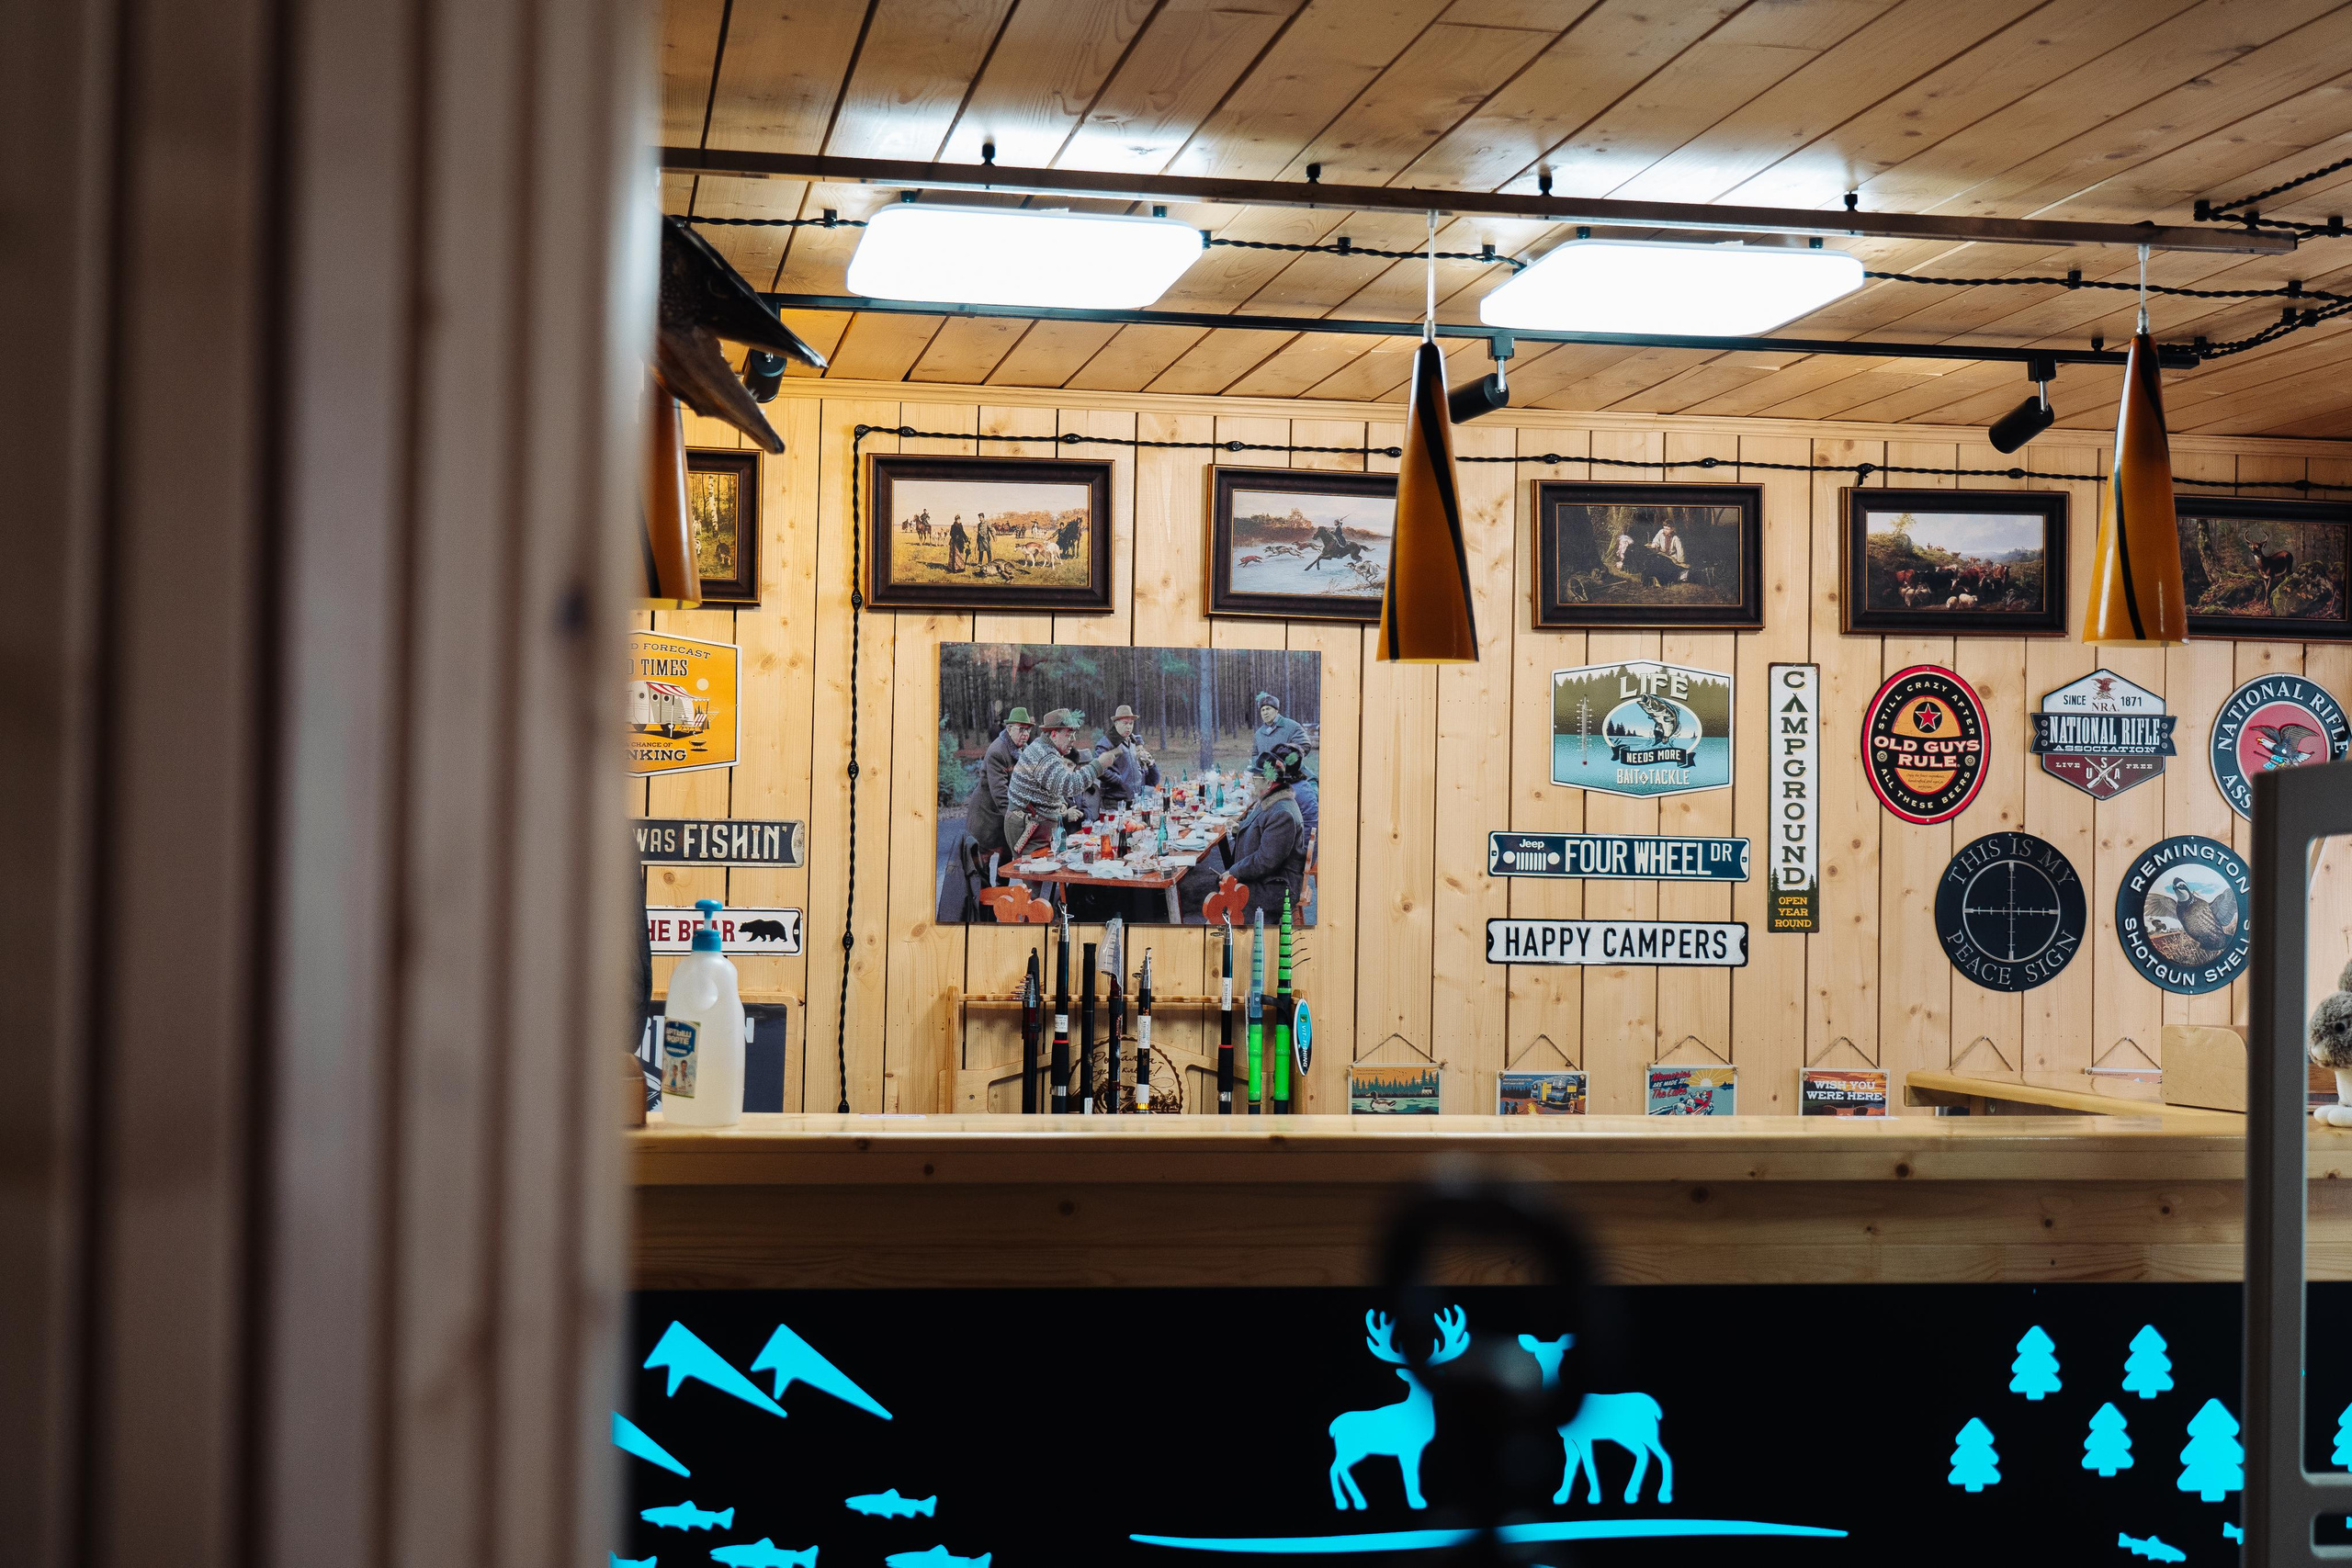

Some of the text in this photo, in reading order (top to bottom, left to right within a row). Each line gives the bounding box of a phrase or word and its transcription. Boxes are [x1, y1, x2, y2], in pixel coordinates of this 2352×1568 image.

[643, 643, 711, 660] FORECAST
[641, 659, 688, 676] TIMES
[1619, 672, 1689, 701] LIFE
[1878, 682, 1974, 735] STILL CRAZY AFTER
[2063, 694, 2143, 707] SINCE 1871
[2217, 681, 2349, 754] NATIONAL RIFLE
[2049, 716, 2160, 746] NATIONAL RIFLE
[1873, 736, 1981, 753] OLD GUYS
[2052, 744, 2156, 753] ASSOCIATION
[627, 750, 686, 761] NKING
[1626, 749, 1681, 763] NEEDS MORE
[1897, 753, 1958, 768] RULE
[1616, 768, 1640, 784] BAIT
[1648, 769, 1690, 785] TACKLE
[1881, 768, 1971, 809] ALL THESE BEERS
[684, 824, 787, 859] FISHIN'
[1519, 839, 1544, 850] Jeep
[1565, 840, 1732, 875] FOUR WHEEL DR
[1948, 837, 2075, 886] THIS IS MY
[2130, 843, 2250, 895] REMINGTON
[1778, 897, 1808, 906] OPEN
[1778, 908, 1808, 917] YEAR
[649, 920, 671, 942] HE
[1774, 919, 1812, 928] ROUND
[1505, 926, 1727, 959] HAPPY CAMPERS
[1946, 929, 2077, 986] PEACE SIGN
[2124, 917, 2196, 987] SHOTGUN
[1814, 1080, 1876, 1090] WISH YOU
[1805, 1090, 1883, 1101] WERE HERE
